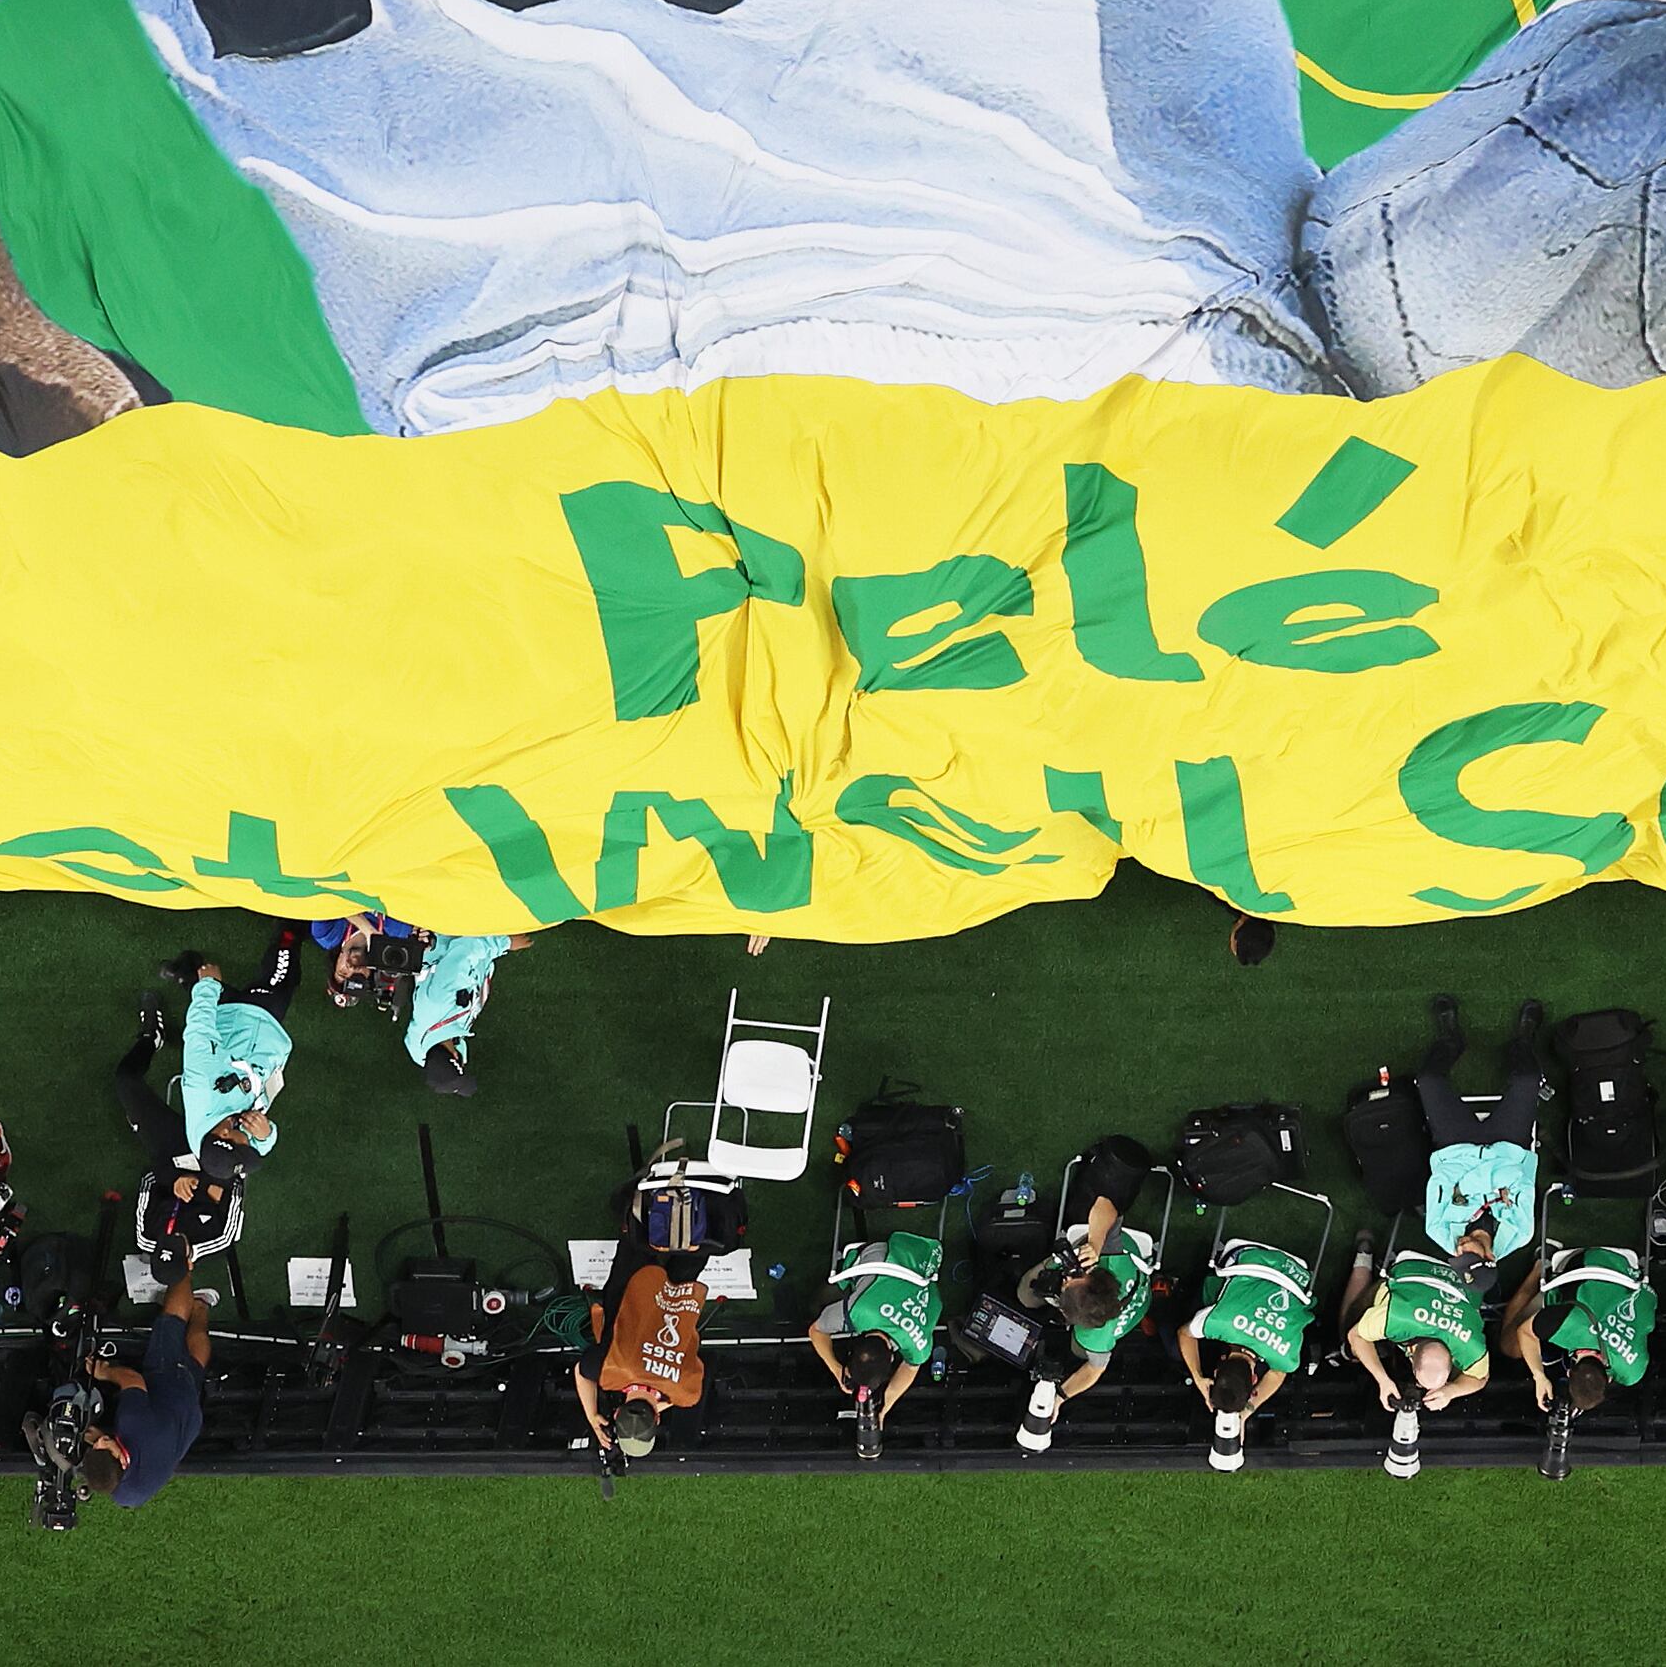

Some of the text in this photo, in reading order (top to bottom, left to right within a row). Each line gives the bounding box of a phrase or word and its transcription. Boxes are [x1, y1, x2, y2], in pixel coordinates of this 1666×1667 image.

[559, 434, 1443, 723] Pelé
[899, 1296, 927, 1324] 002
[1253, 1305, 1287, 1330] 933
[1430, 1296, 1463, 1320] 530
[878, 1302, 927, 1350] PHOTO
[1231, 1312, 1290, 1356] PHOTO
[1412, 1305, 1471, 1343] PHOTO
[1605, 1313, 1635, 1339] 520
[639, 1355, 680, 1382] MRL
